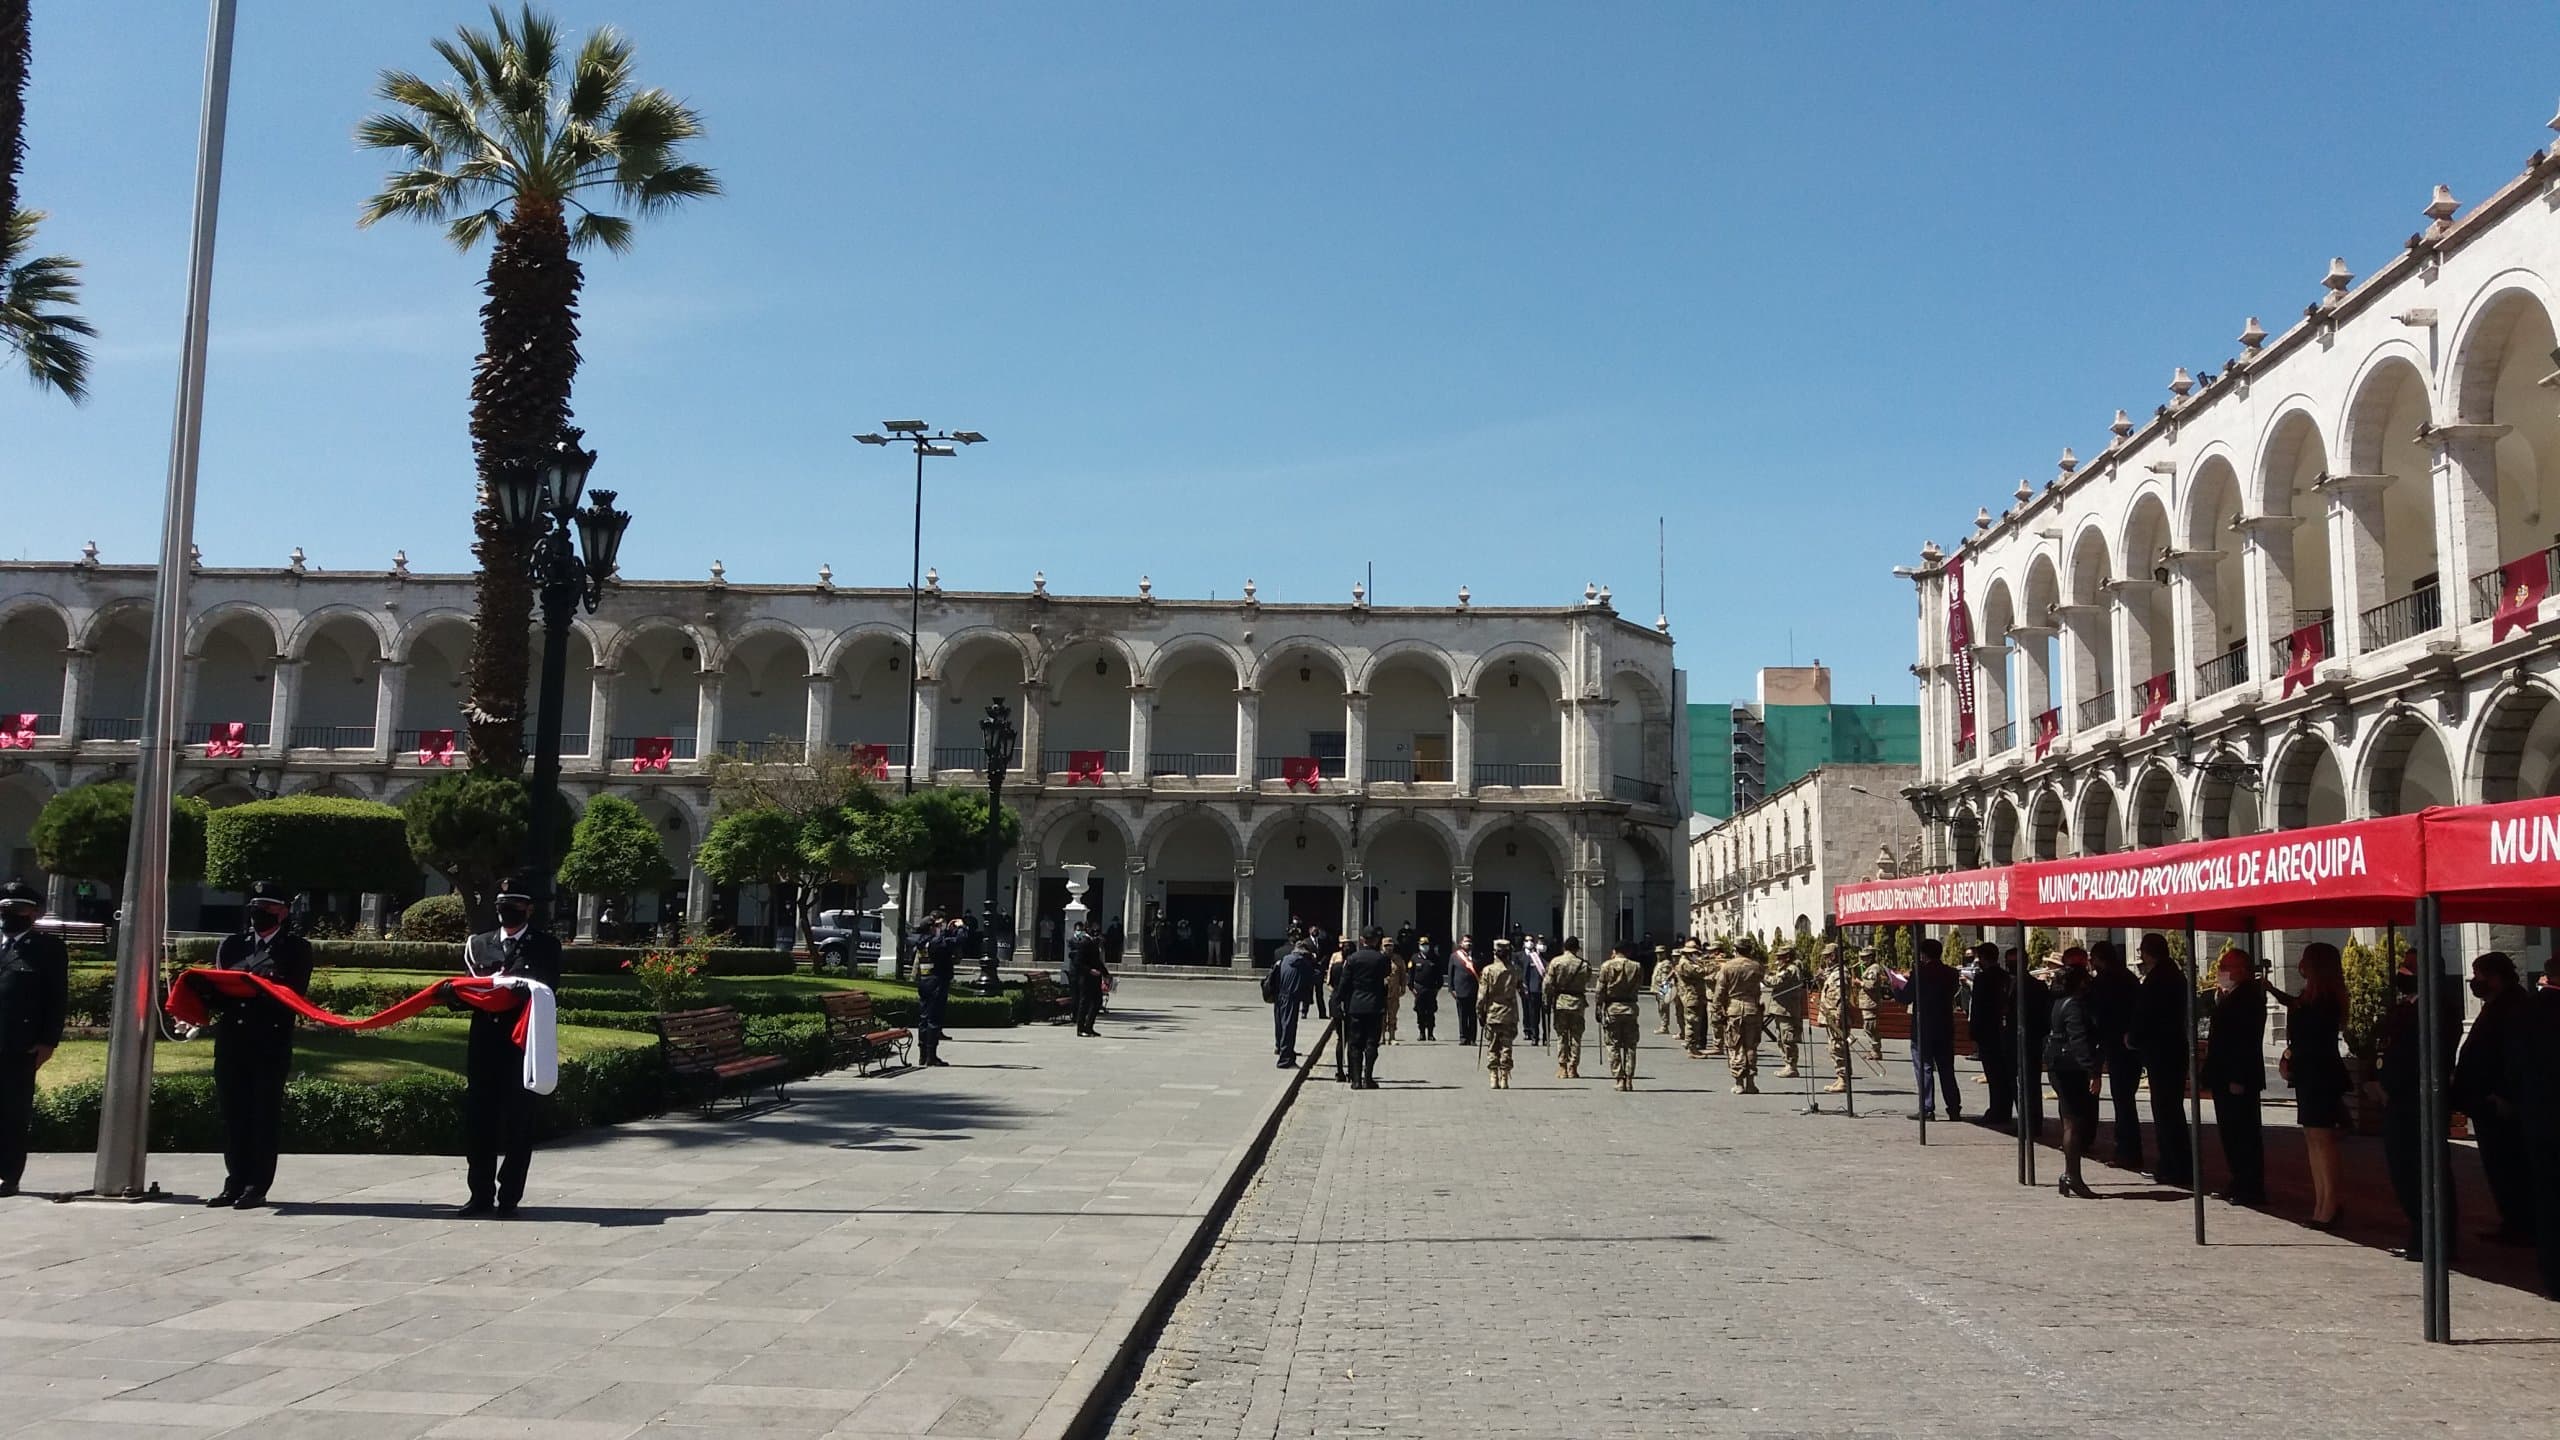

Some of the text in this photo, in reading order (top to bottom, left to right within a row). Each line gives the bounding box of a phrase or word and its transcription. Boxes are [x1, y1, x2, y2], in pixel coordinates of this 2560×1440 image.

[1953, 653, 1968, 714] Personal
[1960, 647, 1974, 714] Municipal
[1845, 880, 1996, 914] MUNICIPALIDAD PROVINCIAL DE AREQUIPA
[2038, 835, 2367, 904] MUNICIPALIDAD PROVINCIAL DE AREQUIPA
[859, 941, 881, 950] OLIC
